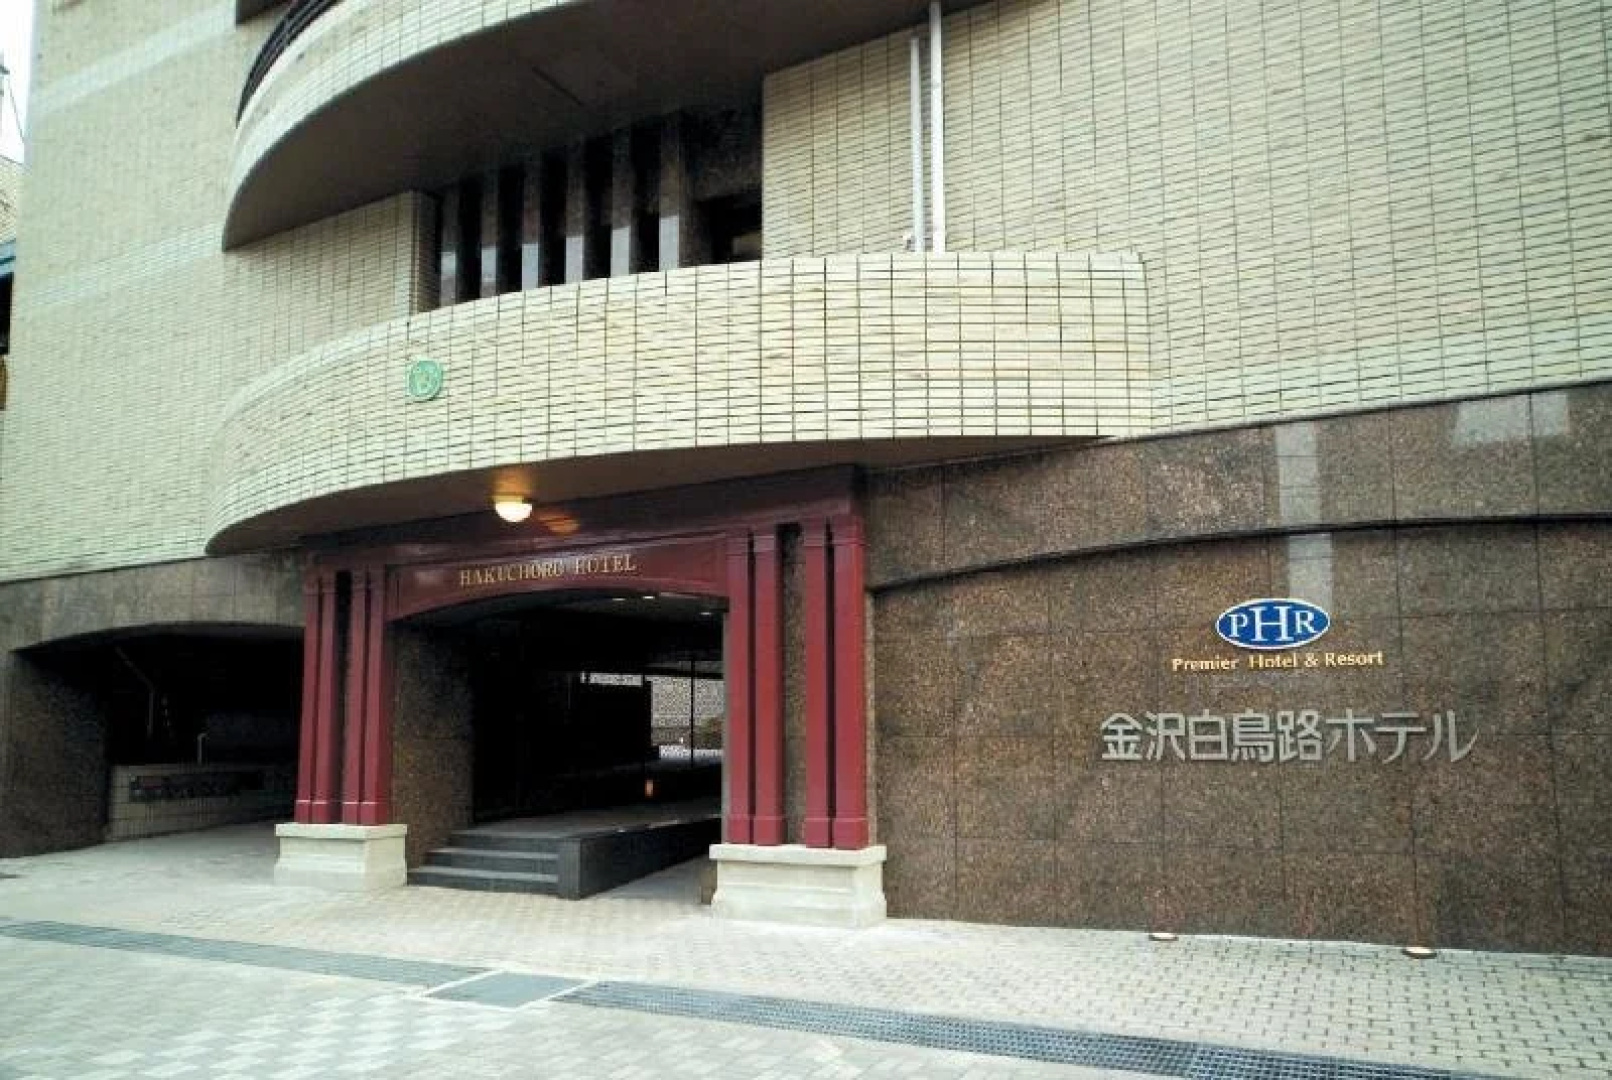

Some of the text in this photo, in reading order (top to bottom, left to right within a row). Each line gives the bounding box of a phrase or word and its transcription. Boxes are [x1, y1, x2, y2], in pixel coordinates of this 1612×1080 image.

[575, 553, 637, 574] HOTEL
[1228, 606, 1318, 642] PHR
[1172, 651, 1384, 672] Premier Hotel & Resort
[1101, 708, 1480, 763] 金沢白鳥路ホテル
